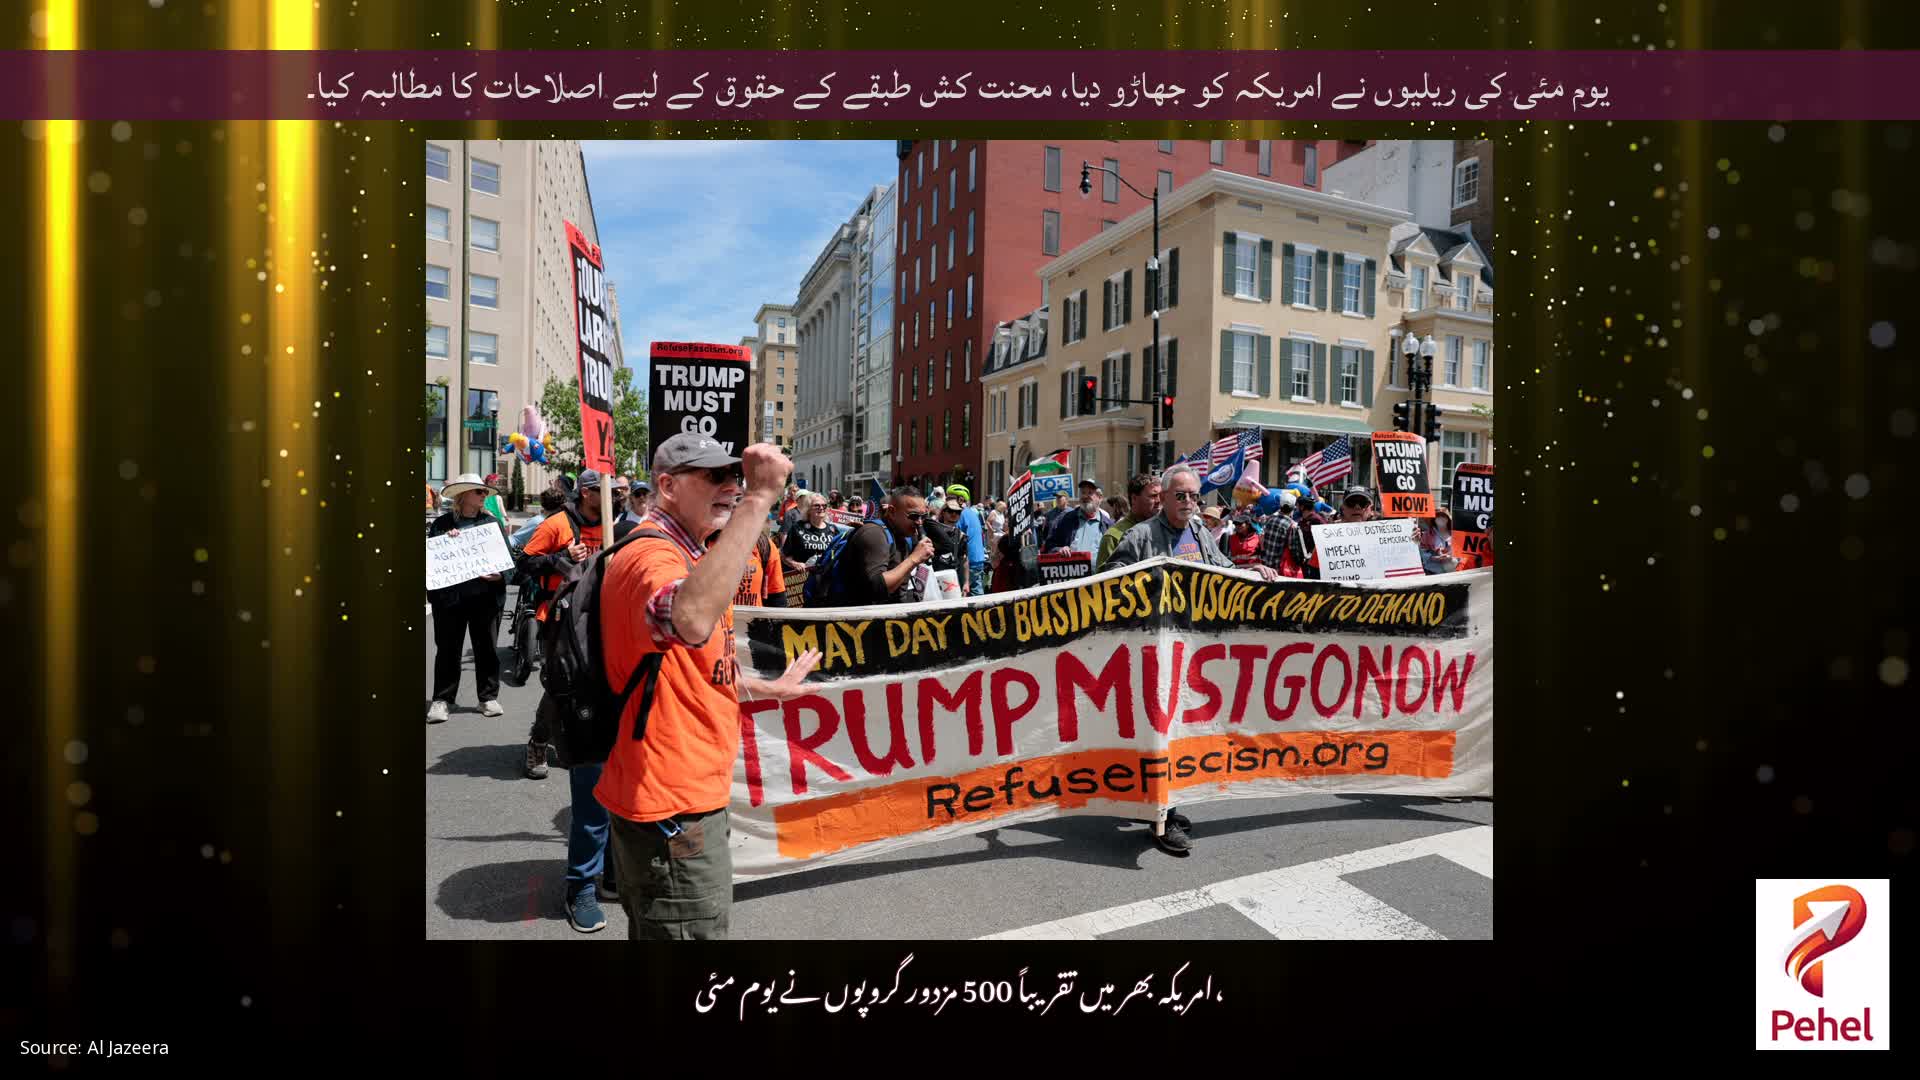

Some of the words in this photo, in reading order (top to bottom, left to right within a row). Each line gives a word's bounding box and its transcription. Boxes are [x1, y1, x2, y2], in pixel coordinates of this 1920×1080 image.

[656, 343, 744, 356] RefuseFascism.org
[582, 351, 612, 403] TRU
[655, 364, 745, 389] TRUMP
[663, 389, 736, 413] MUST
[680, 415, 718, 437] GO
[597, 419, 613, 457] Y
[1375, 443, 1423, 458] TRUMP
[1383, 460, 1421, 474] MUST
[1034, 477, 1071, 492] NOPE
[1396, 475, 1416, 491] GO
[1008, 482, 1031, 506] TRUMP
[1011, 494, 1030, 516] MUST
[1391, 496, 1429, 513] NOW!
[1016, 509, 1026, 523] GO
[1322, 527, 1343, 539] SAVE
[1345, 526, 1362, 536] OUR
[1364, 524, 1402, 535] DISTRESSED
[434, 541, 489, 561] AGAINST
[1324, 544, 1361, 557] IMPEACH
[1041, 564, 1089, 578] TRUMP
[1328, 559, 1367, 571] DICTATOR
[781, 620, 871, 672] MAY
[884, 614, 953, 657] DAY
[960, 607, 1007, 645] NO
[1014, 569, 1153, 643] BUSINESS
[1159, 568, 1186, 615] AS
[1190, 570, 1267, 623] USUAL
[1260, 590, 1285, 620] A
[1281, 591, 1335, 623] DAY
[1329, 594, 1362, 620] TO
[1358, 591, 1446, 626] DEMAND
[737, 666, 1041, 808] TRUMP
